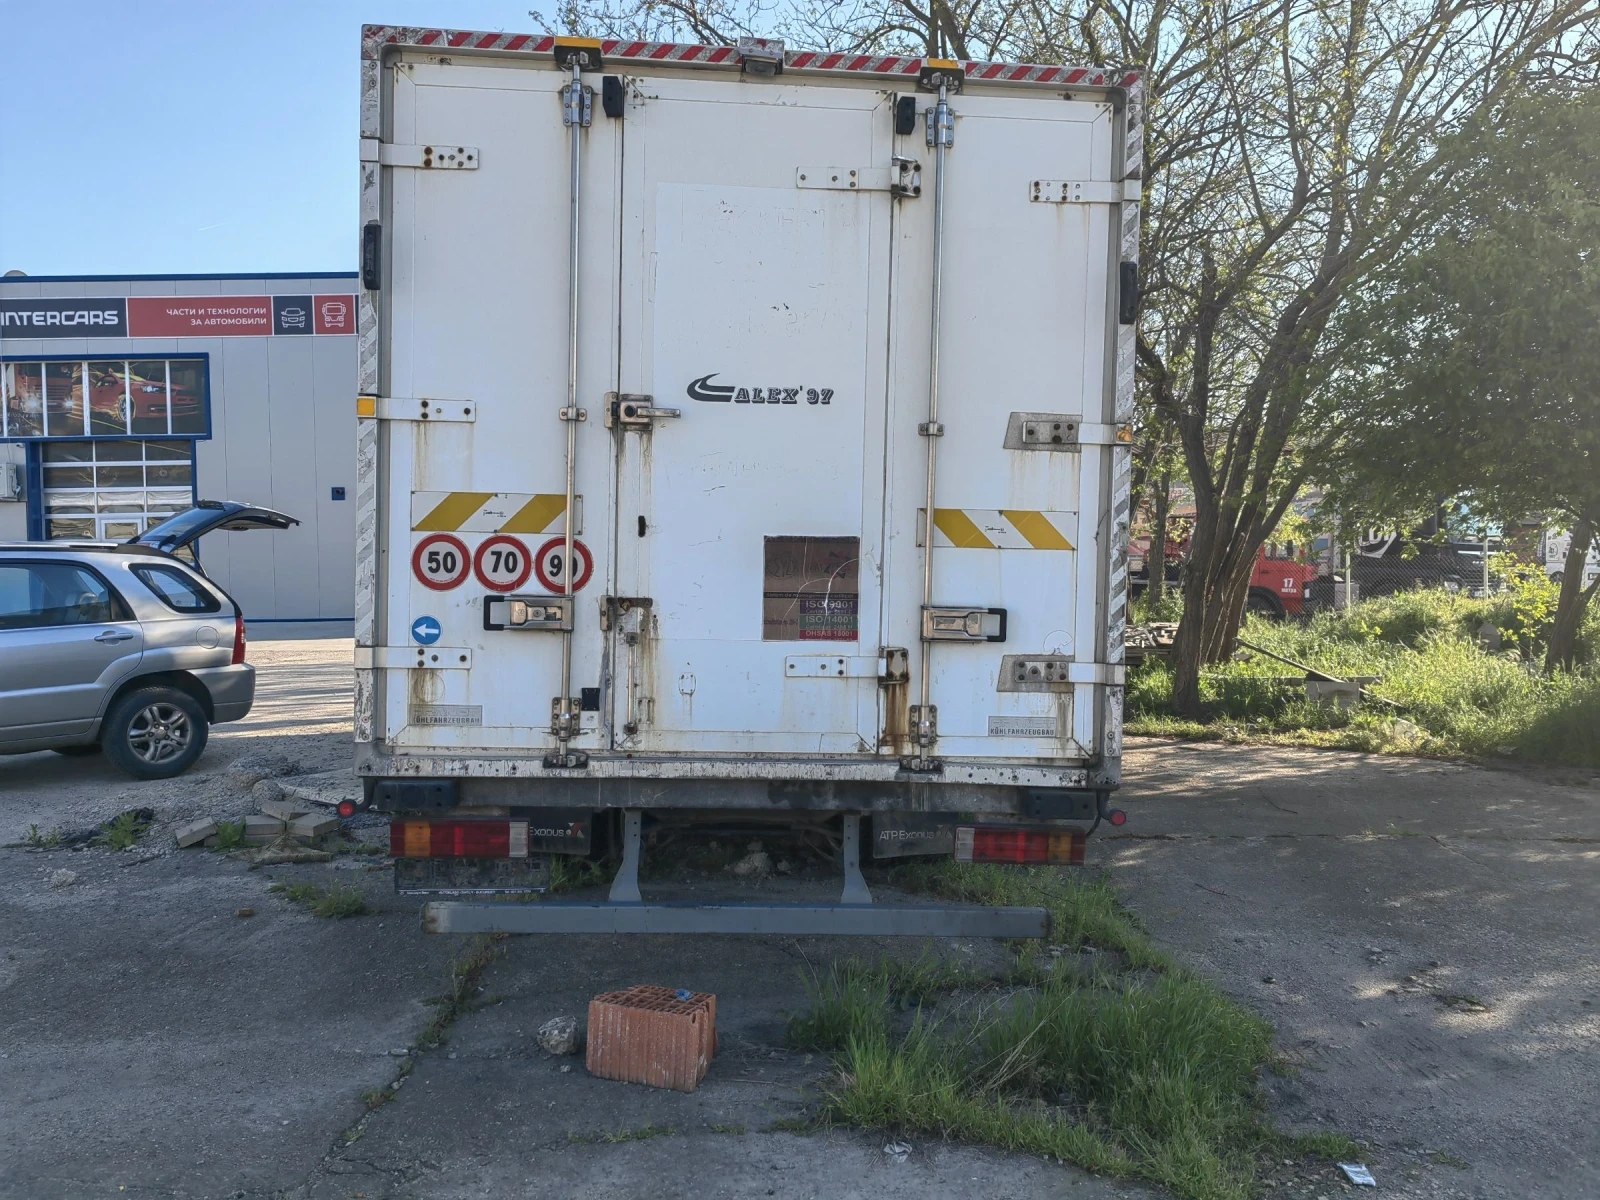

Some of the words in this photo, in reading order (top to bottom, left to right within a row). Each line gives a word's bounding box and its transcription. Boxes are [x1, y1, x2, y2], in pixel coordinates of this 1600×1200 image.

[166, 308, 196, 316] ЧАСТИ
[207, 307, 267, 315] ТЕХНОЛОГИИ
[0, 310, 119, 326] INTERCARS
[190, 318, 202, 326] ЗА
[427, 551, 457, 574] 50
[490, 551, 518, 573] 70
[1283, 577, 1294, 588] 17
[805, 600, 825, 608] ISO
[805, 615, 823, 623] ISO
[827, 615, 853, 623] 14001
